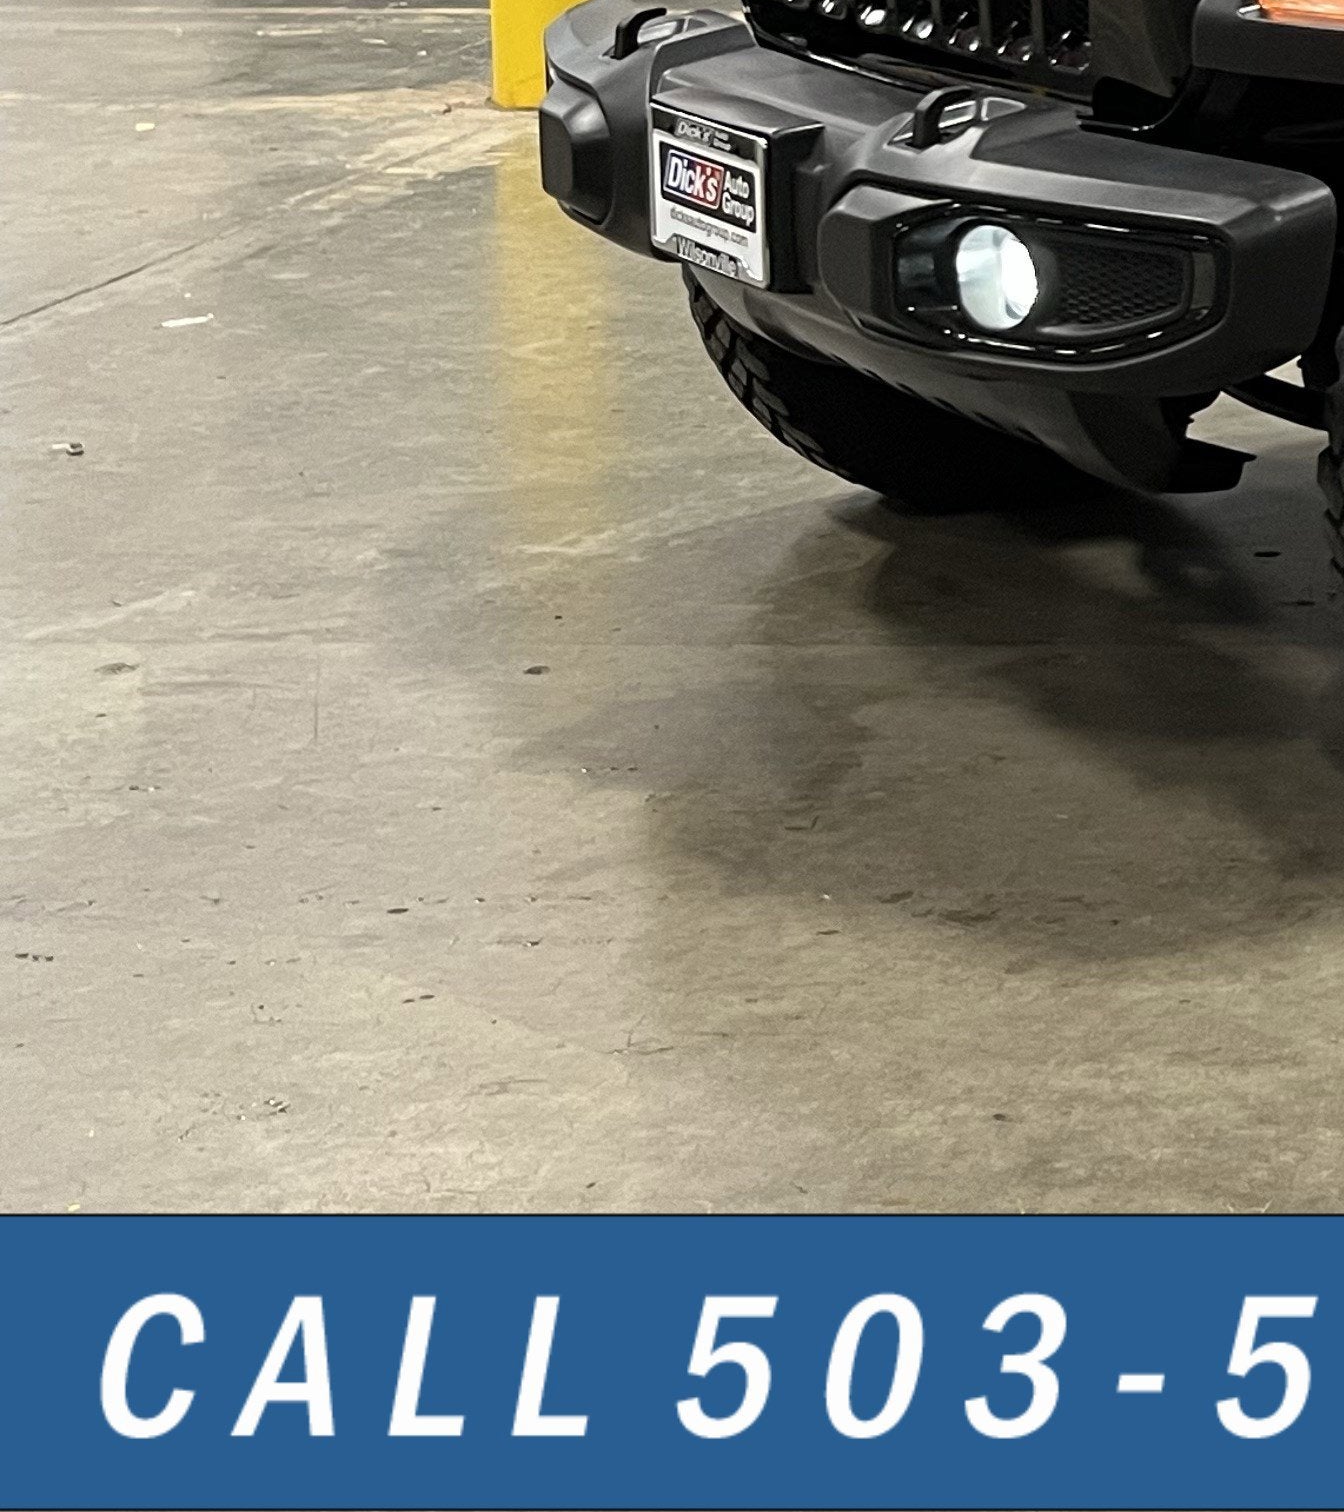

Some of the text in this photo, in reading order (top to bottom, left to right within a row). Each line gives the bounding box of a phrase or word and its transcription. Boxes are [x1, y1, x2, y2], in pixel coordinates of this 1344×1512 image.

[668, 156, 719, 202] Dick's
[724, 170, 750, 199] Auto
[721, 192, 755, 227] Group
